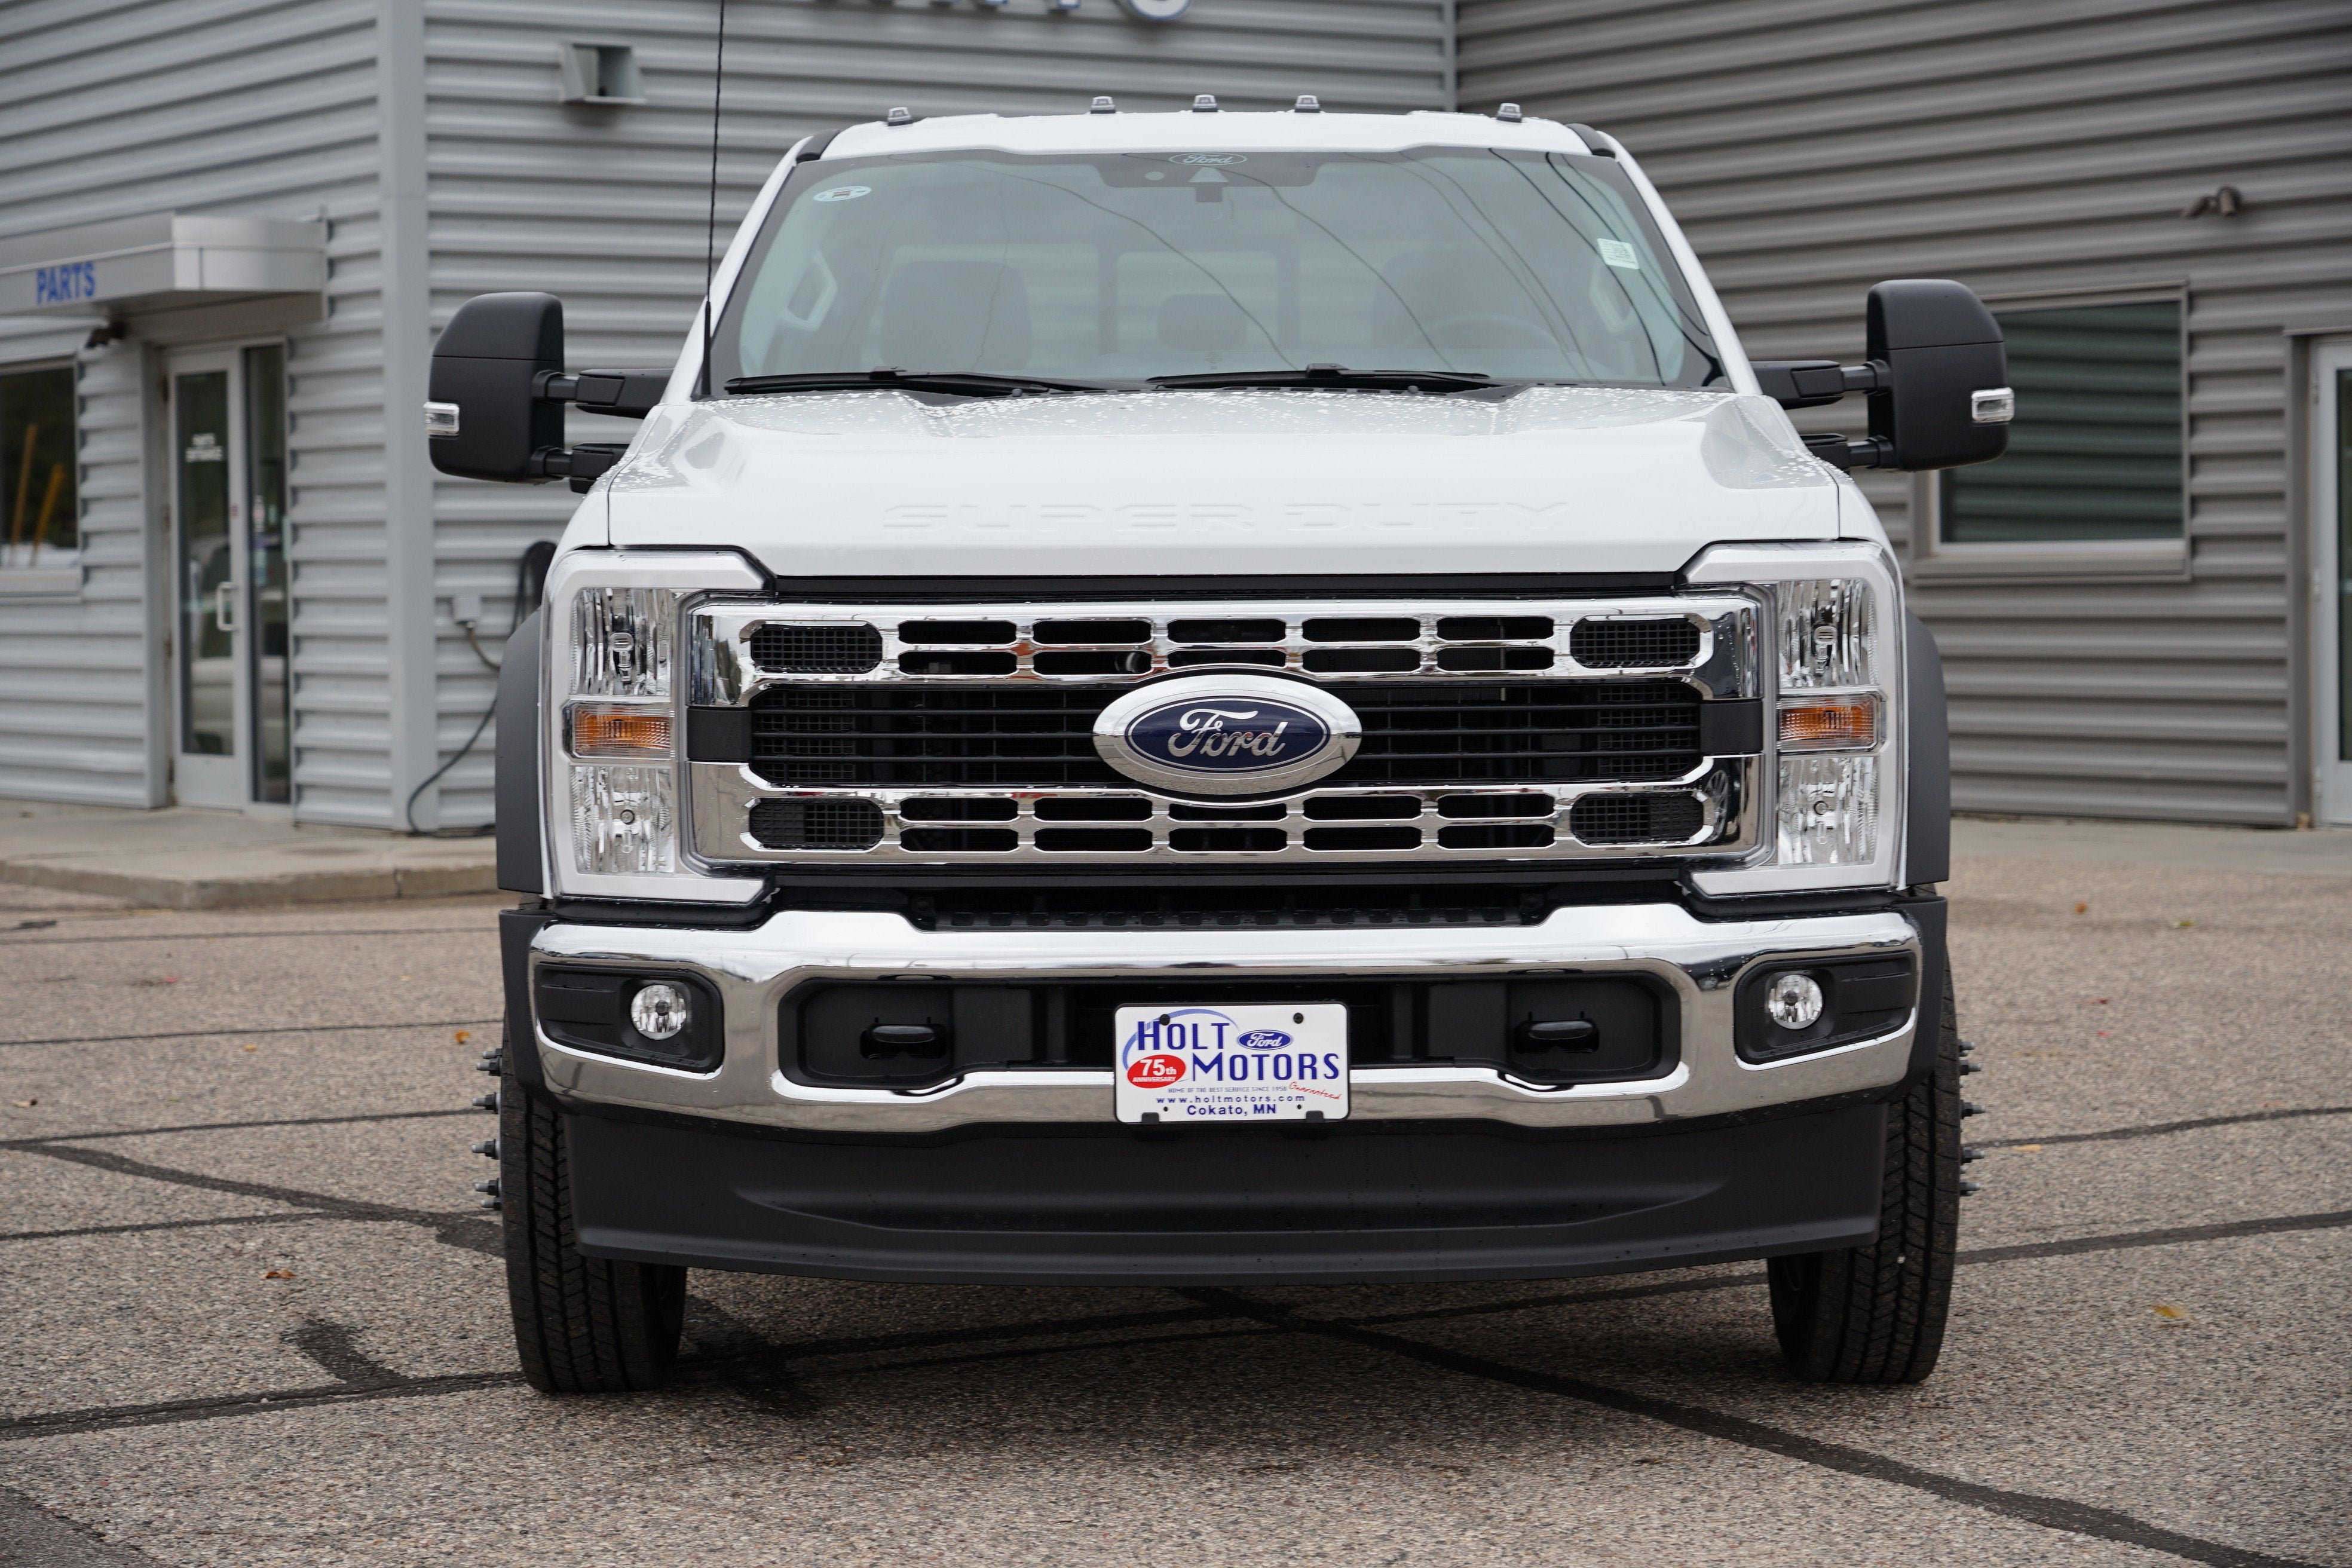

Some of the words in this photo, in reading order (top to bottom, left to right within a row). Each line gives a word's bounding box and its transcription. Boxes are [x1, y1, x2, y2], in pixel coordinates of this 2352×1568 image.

[1183, 154, 1234, 163] Ford
[37, 261, 95, 305] PARTS
[881, 504, 1255, 532] SUPER
[1284, 502, 1569, 531] DUTY
[1167, 708, 1288, 757] Ford
[1138, 1021, 1230, 1051] HOLT
[1247, 1032, 1283, 1047] Ford
[1140, 1059, 1177, 1076] 75th
[1193, 1052, 1339, 1082] MOTORS
[1156, 1095, 1305, 1104] www.holtmotors.com
[1288, 1082, 1342, 1101] Guaranteed
[1187, 1104, 1248, 1116] Cokato,
[1253, 1104, 1277, 1114] MN
